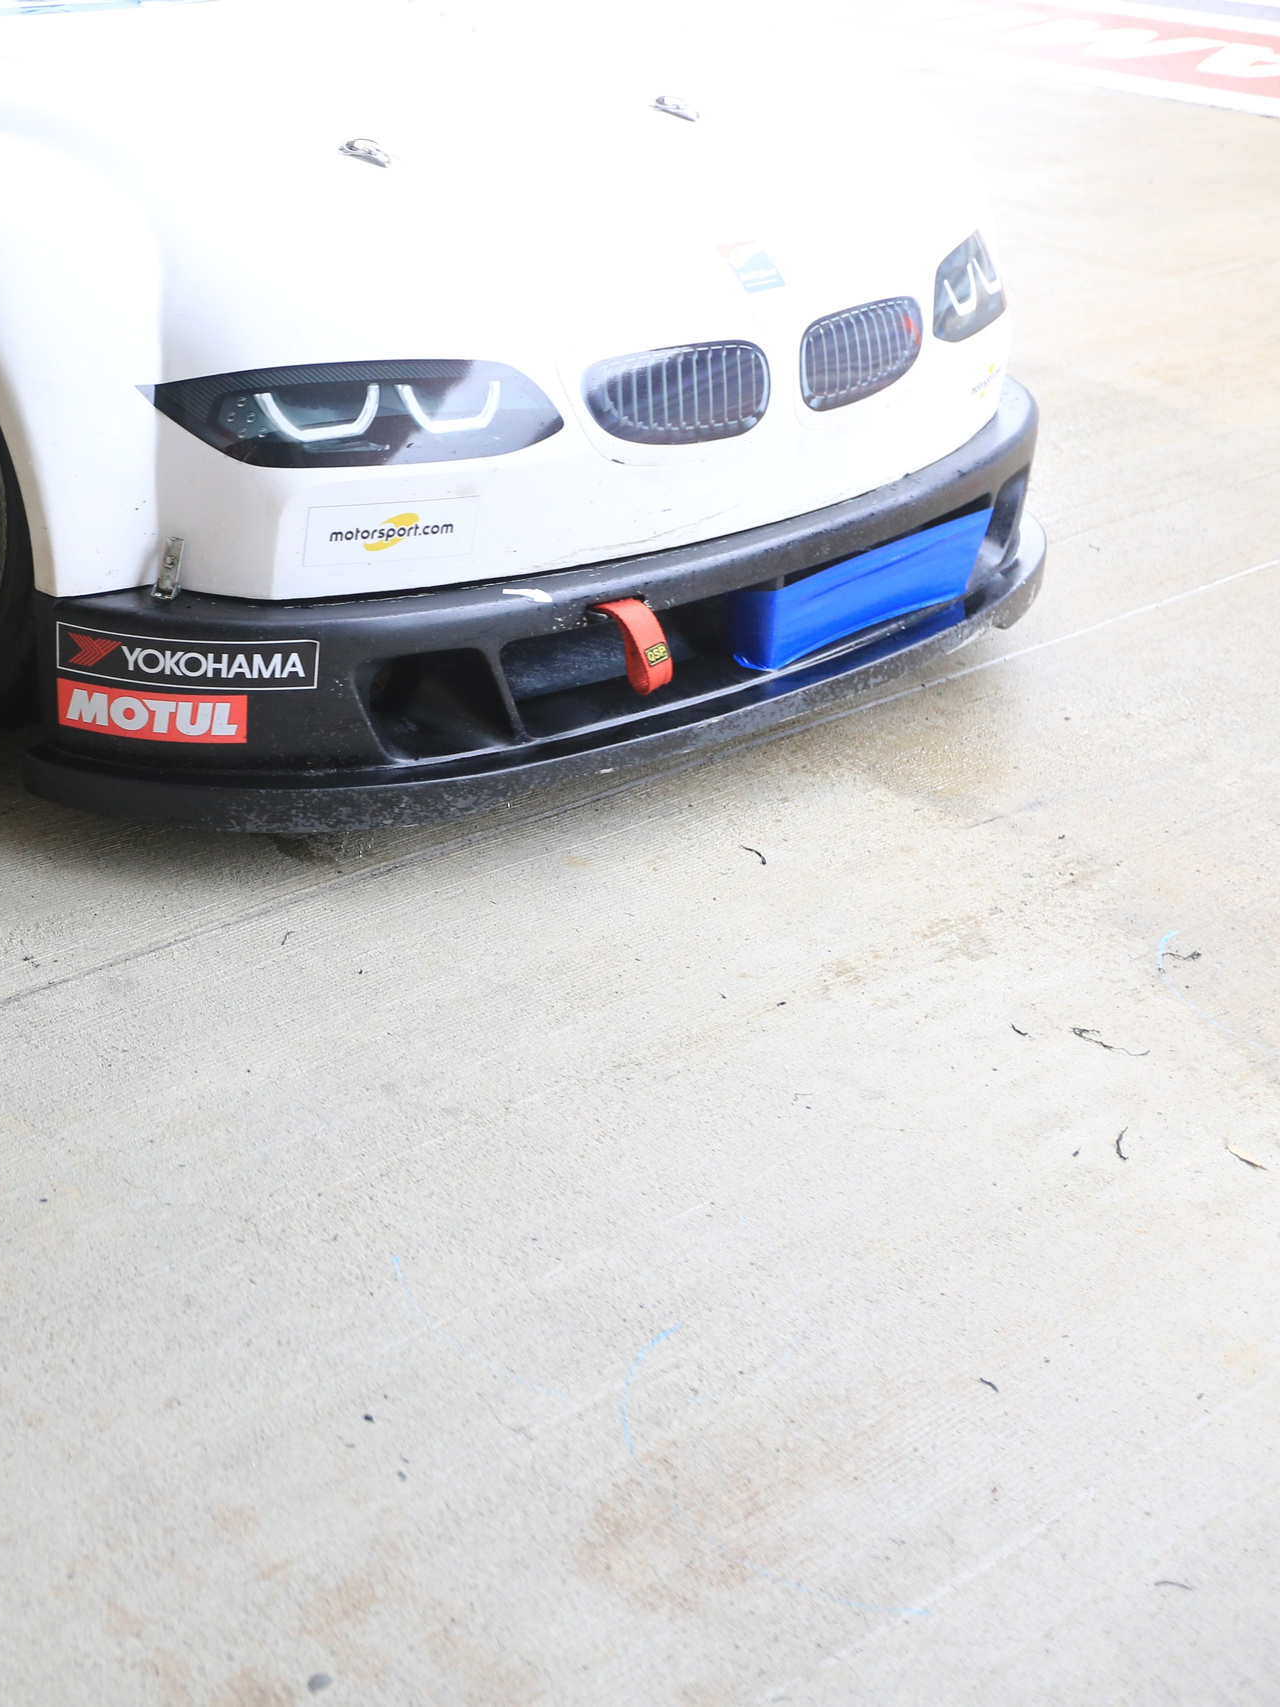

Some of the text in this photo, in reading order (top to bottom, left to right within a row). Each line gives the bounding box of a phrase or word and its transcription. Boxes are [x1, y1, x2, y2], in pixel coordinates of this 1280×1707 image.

[329, 523, 454, 542] motorsport.com
[121, 645, 306, 679] YOKOHAMA
[66, 688, 238, 736] MOTUL
